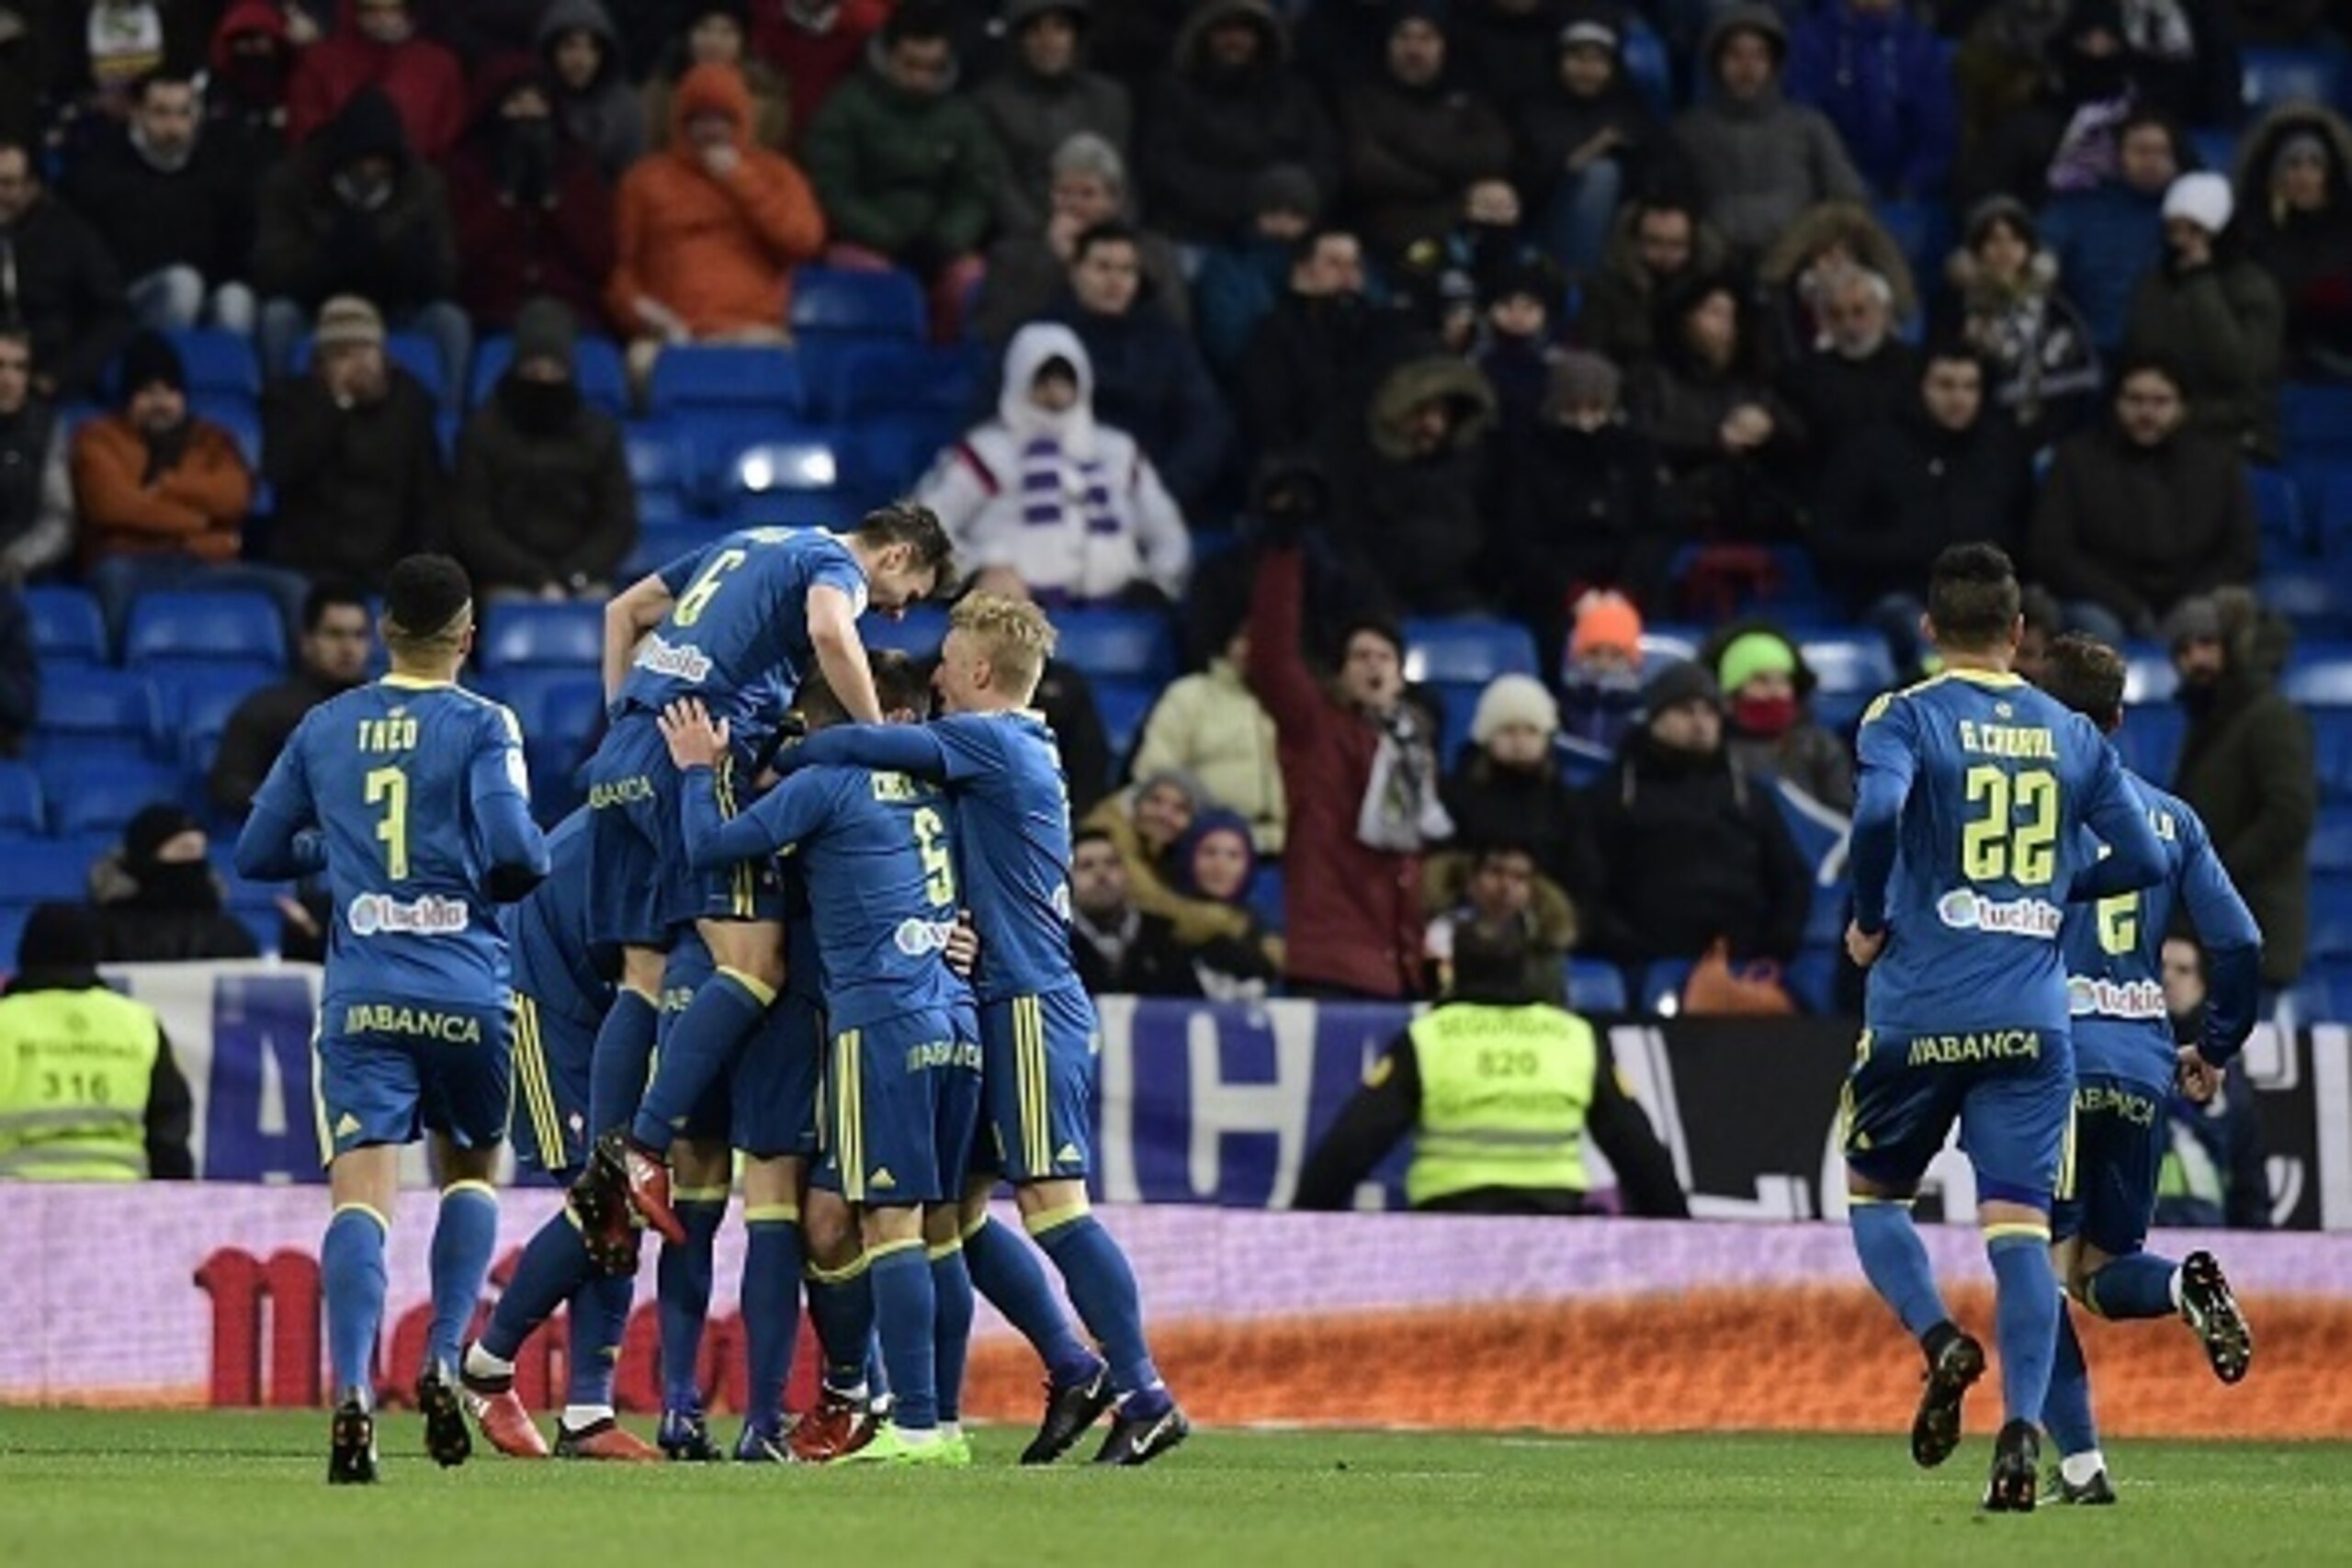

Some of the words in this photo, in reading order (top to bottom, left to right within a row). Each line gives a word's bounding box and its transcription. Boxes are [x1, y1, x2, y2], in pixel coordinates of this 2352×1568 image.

[1962, 763, 2059, 885] 22
[1922, 1031, 2040, 1064] ABANCA
[43, 1070, 111, 1103] 316
